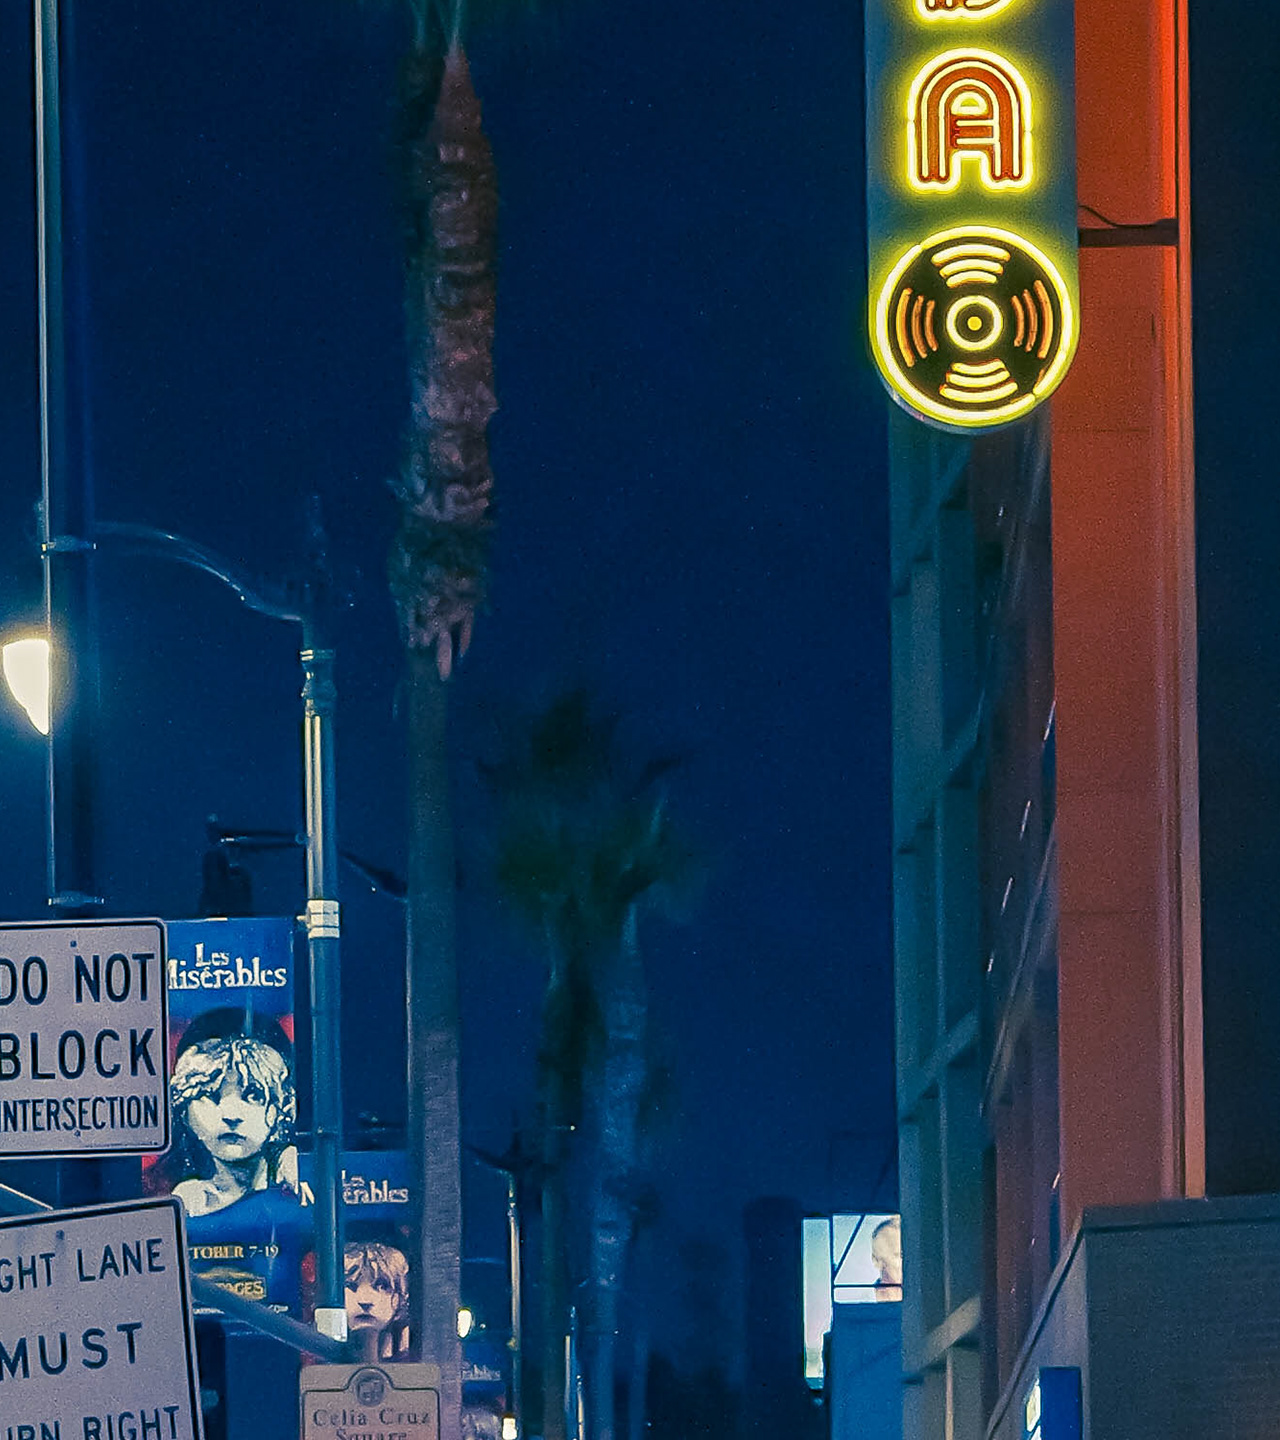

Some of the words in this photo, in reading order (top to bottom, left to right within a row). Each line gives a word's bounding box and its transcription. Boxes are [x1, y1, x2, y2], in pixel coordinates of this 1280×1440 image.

[195, 942, 230, 968] Les
[74, 953, 154, 1003] NOT
[77, 1238, 166, 1281] LANE
[312, 1409, 368, 1427] Celia
